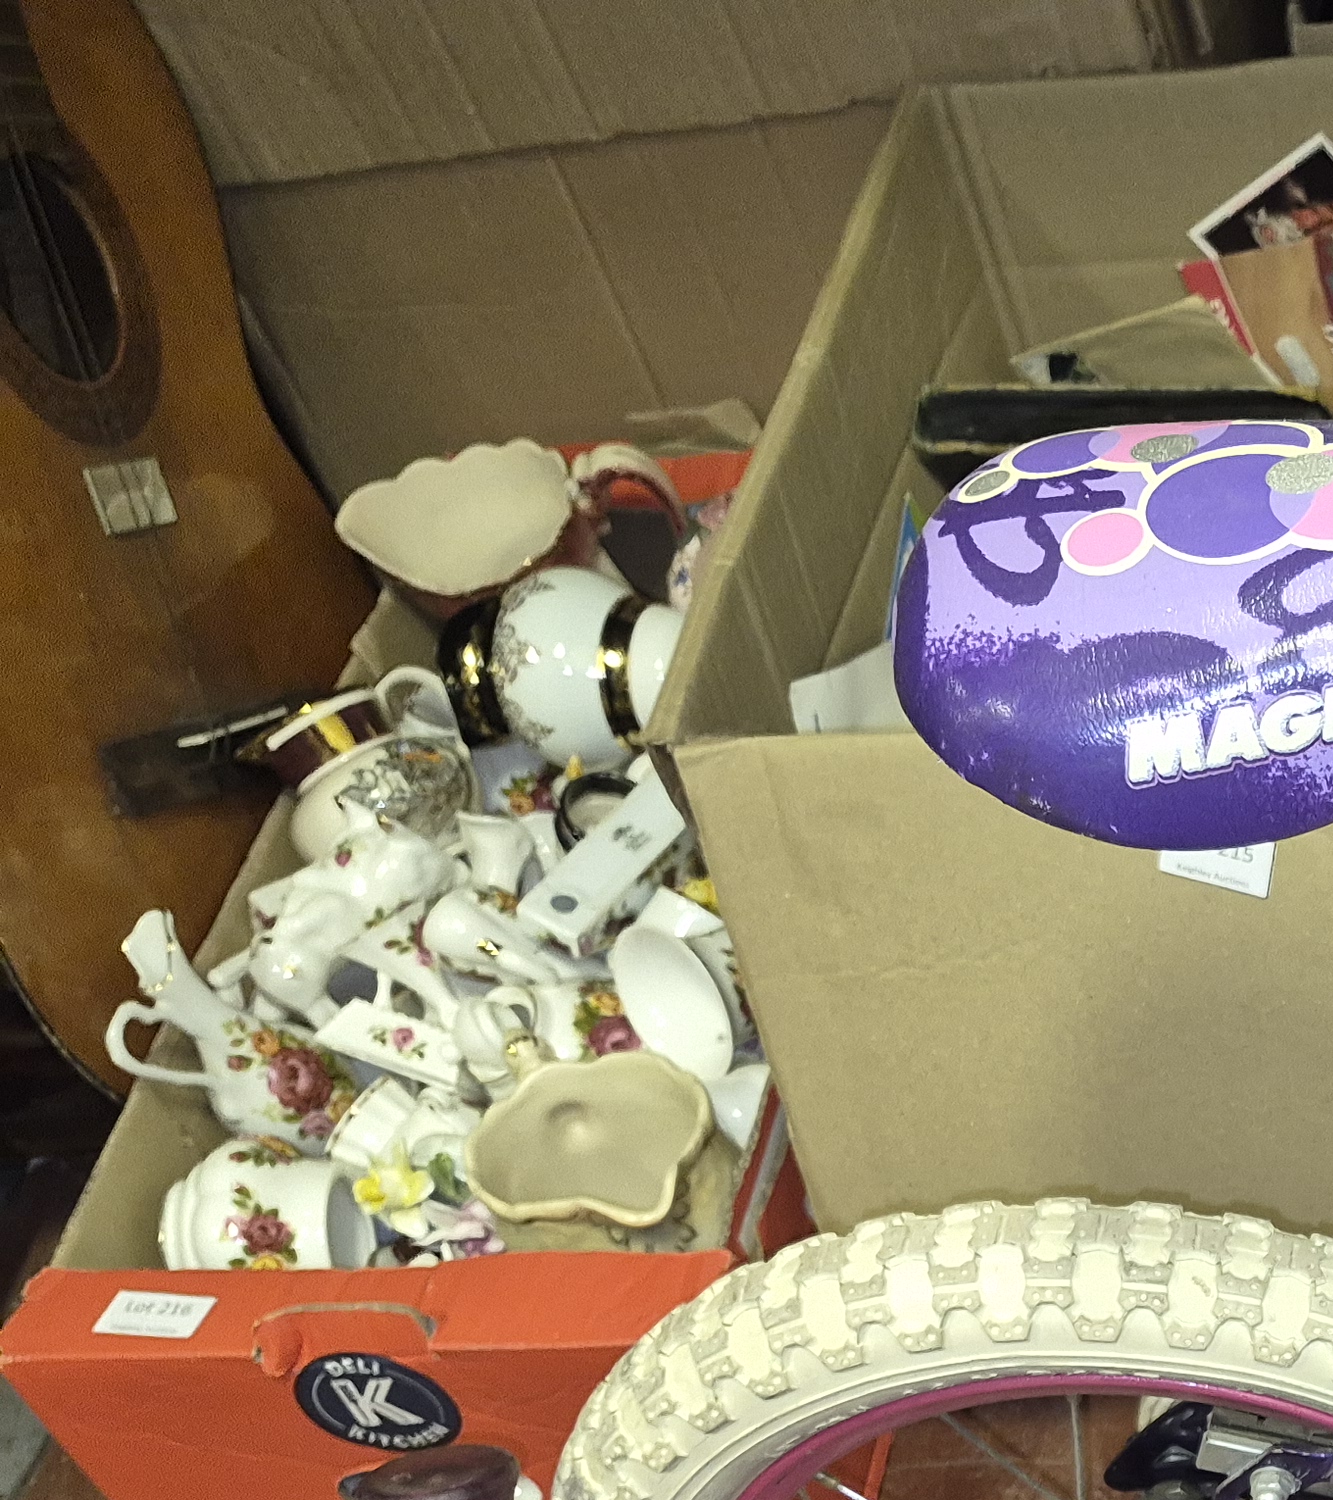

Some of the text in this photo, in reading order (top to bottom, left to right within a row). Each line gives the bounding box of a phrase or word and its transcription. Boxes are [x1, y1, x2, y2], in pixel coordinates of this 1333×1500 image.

[324, 1356, 381, 1378] DELI
[330, 1376, 426, 1428] K
[347, 1422, 450, 1450] KITCHEN
